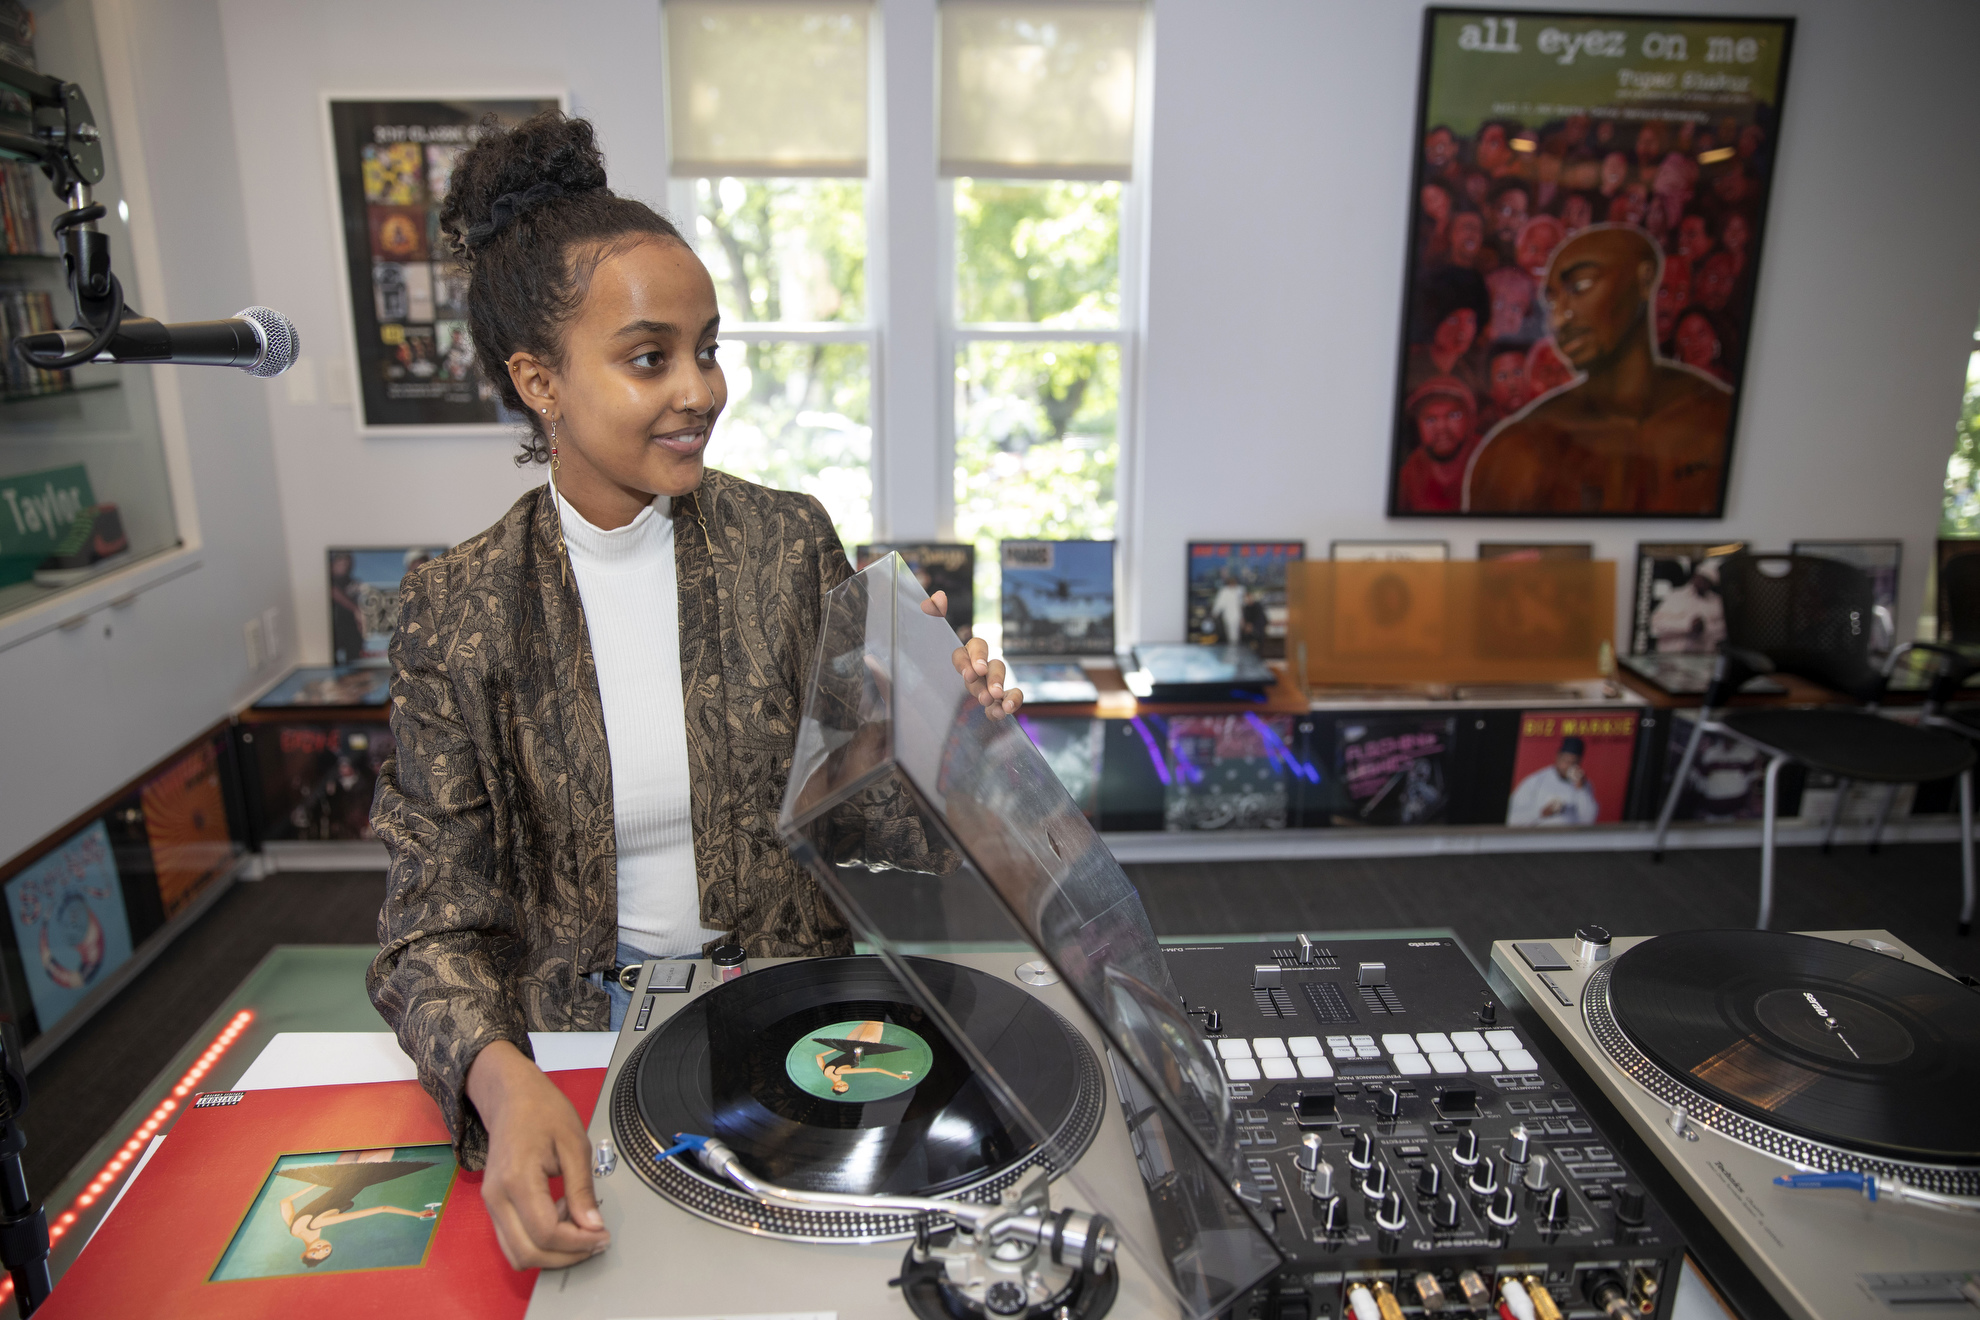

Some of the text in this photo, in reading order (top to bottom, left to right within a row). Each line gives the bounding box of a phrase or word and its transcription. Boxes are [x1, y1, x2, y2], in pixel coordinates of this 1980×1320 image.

[1458, 18, 1759, 65] all eyez on me
[2, 481, 82, 540] Taylor
[1523, 717, 1635, 737] BIZ MARKIE
[1803, 992, 1828, 1017] serato
[1714, 1159, 1746, 1195] Technics
[1435, 1238, 1502, 1248] Pioneer
